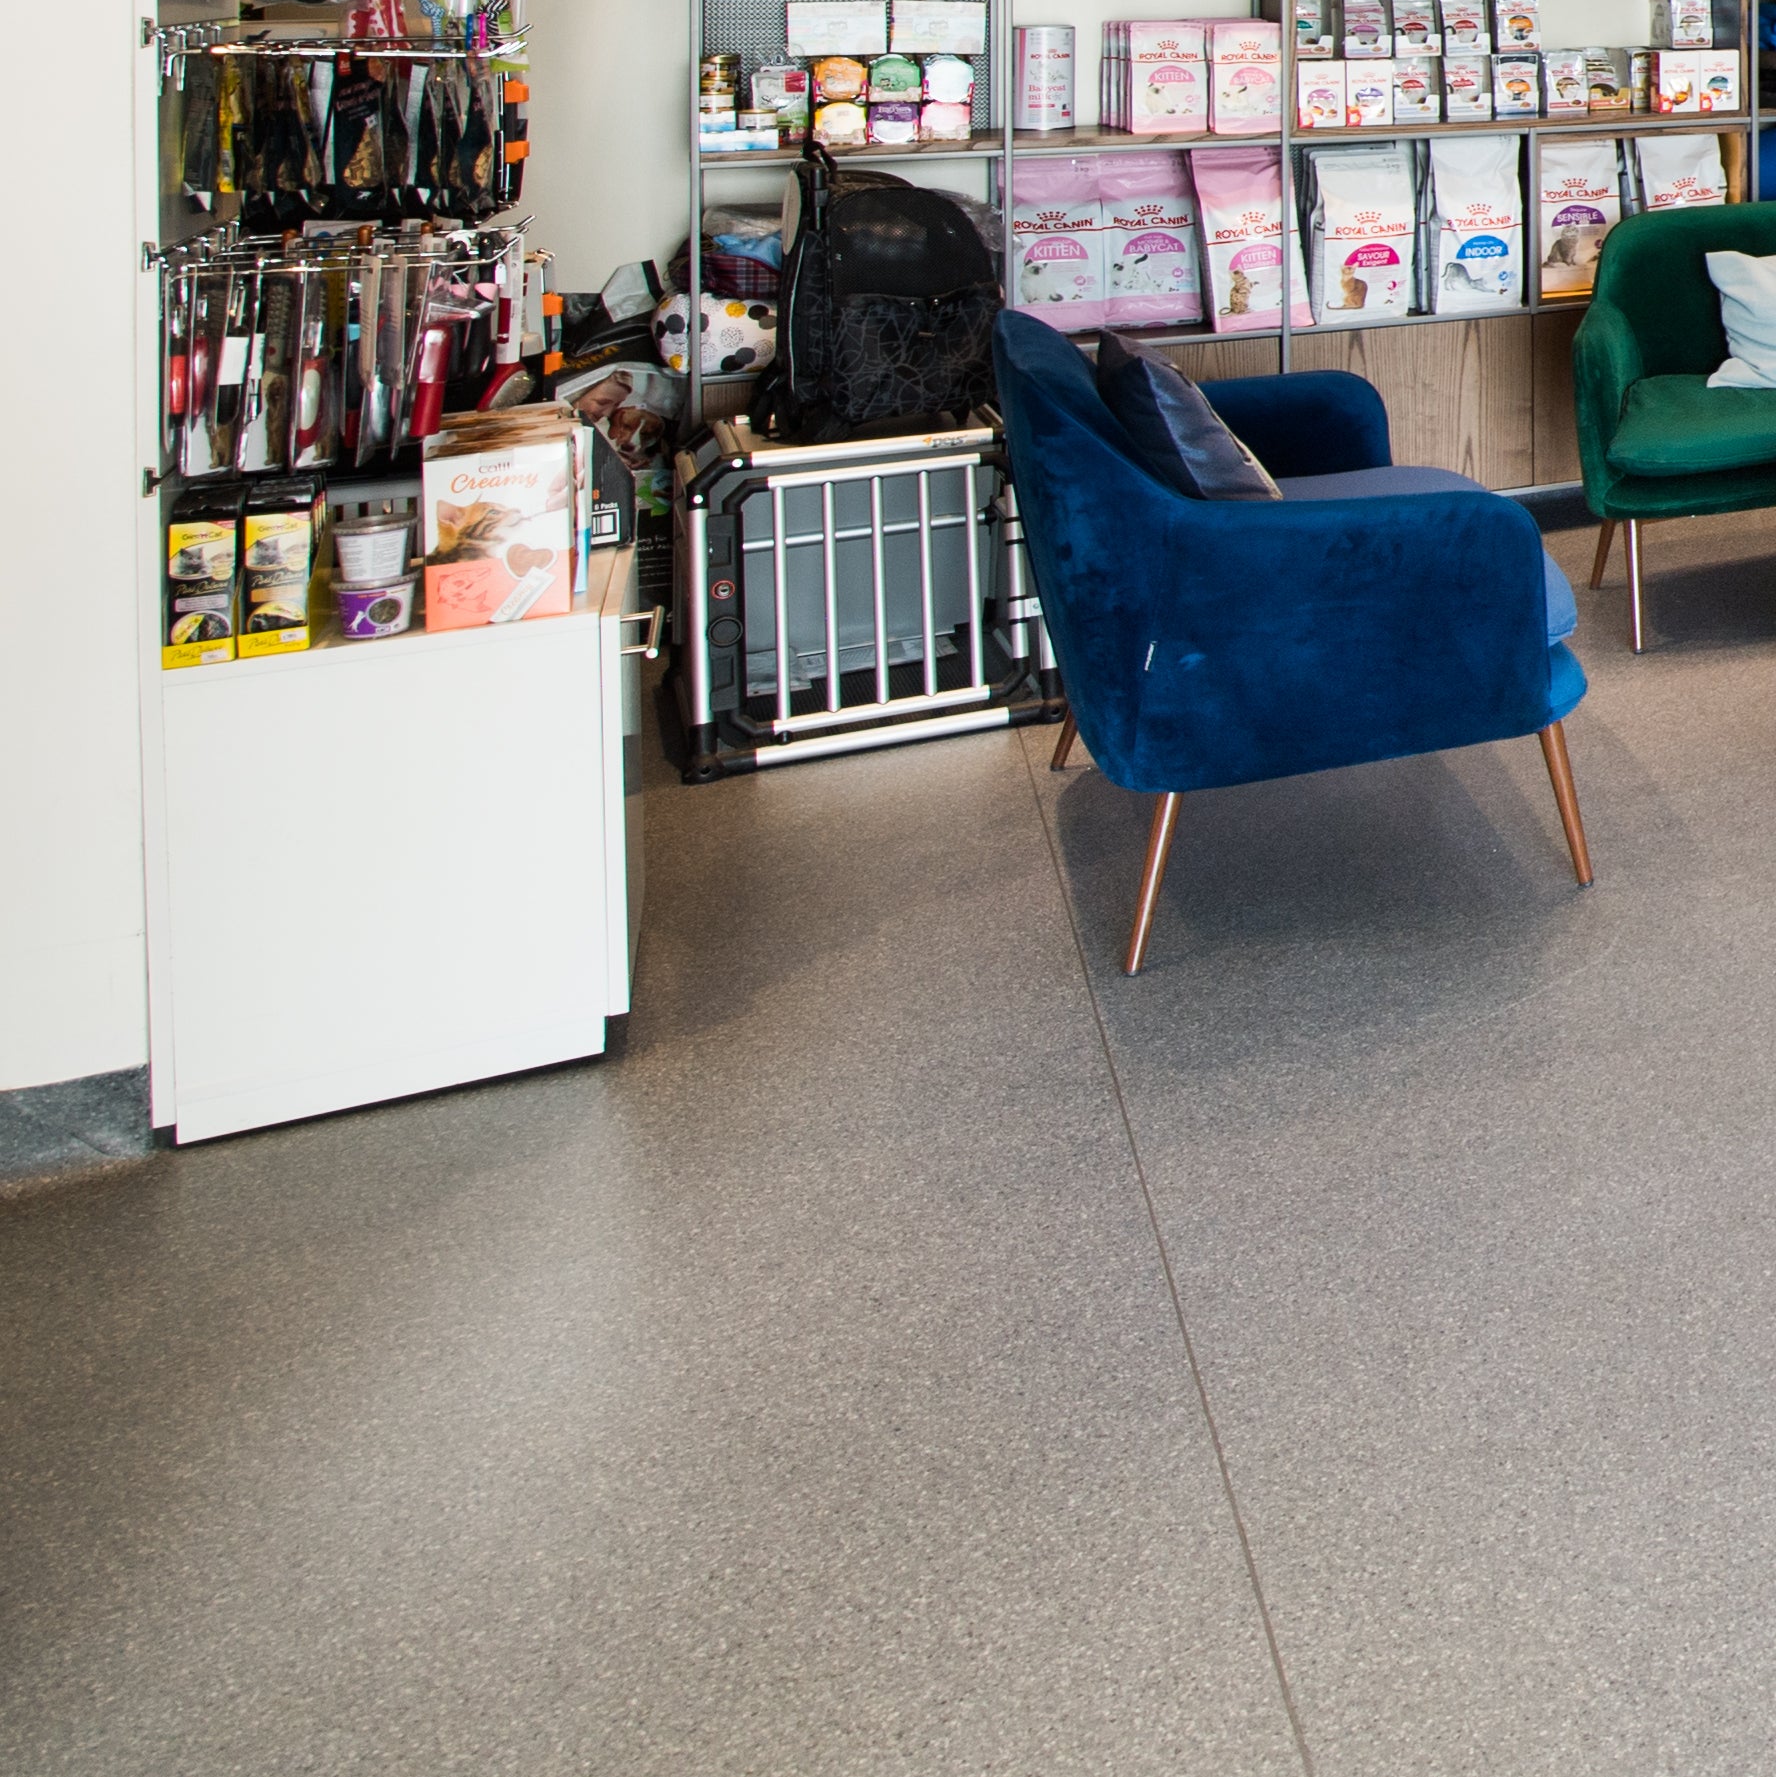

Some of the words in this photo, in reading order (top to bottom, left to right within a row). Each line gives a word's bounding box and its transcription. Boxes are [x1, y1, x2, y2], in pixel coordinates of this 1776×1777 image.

[1139, 52, 1169, 60] ROYAL
[1171, 52, 1198, 60] CANIN
[1221, 53, 1249, 61] ROYAL
[1251, 53, 1278, 61] CANIN
[1154, 72, 1189, 82] KITTEN
[1028, 83, 1067, 93] Baycat
[1113, 216, 1148, 227] ROYAL
[1151, 214, 1189, 225] CANIN
[1447, 218, 1478, 228] ROYAL
[1481, 215, 1512, 227] CANIN
[1557, 211, 1598, 223] SENSIBLE
[1013, 220, 1050, 231] ROYAL
[1053, 218, 1094, 230] CANIN
[1335, 224, 1367, 236] ROYAL
[1370, 223, 1407, 234] CANIN
[1215, 227, 1253, 240] ROYAL
[1033, 244, 1080, 258] KITTEN
[1129, 243, 1178, 253] BABYCAT
[1464, 246, 1503, 256] INDOOR
[1240, 250, 1277, 263] KITTEN
[1356, 250, 1390, 261] SAVOUR
[451, 470, 539, 495] Creamy
